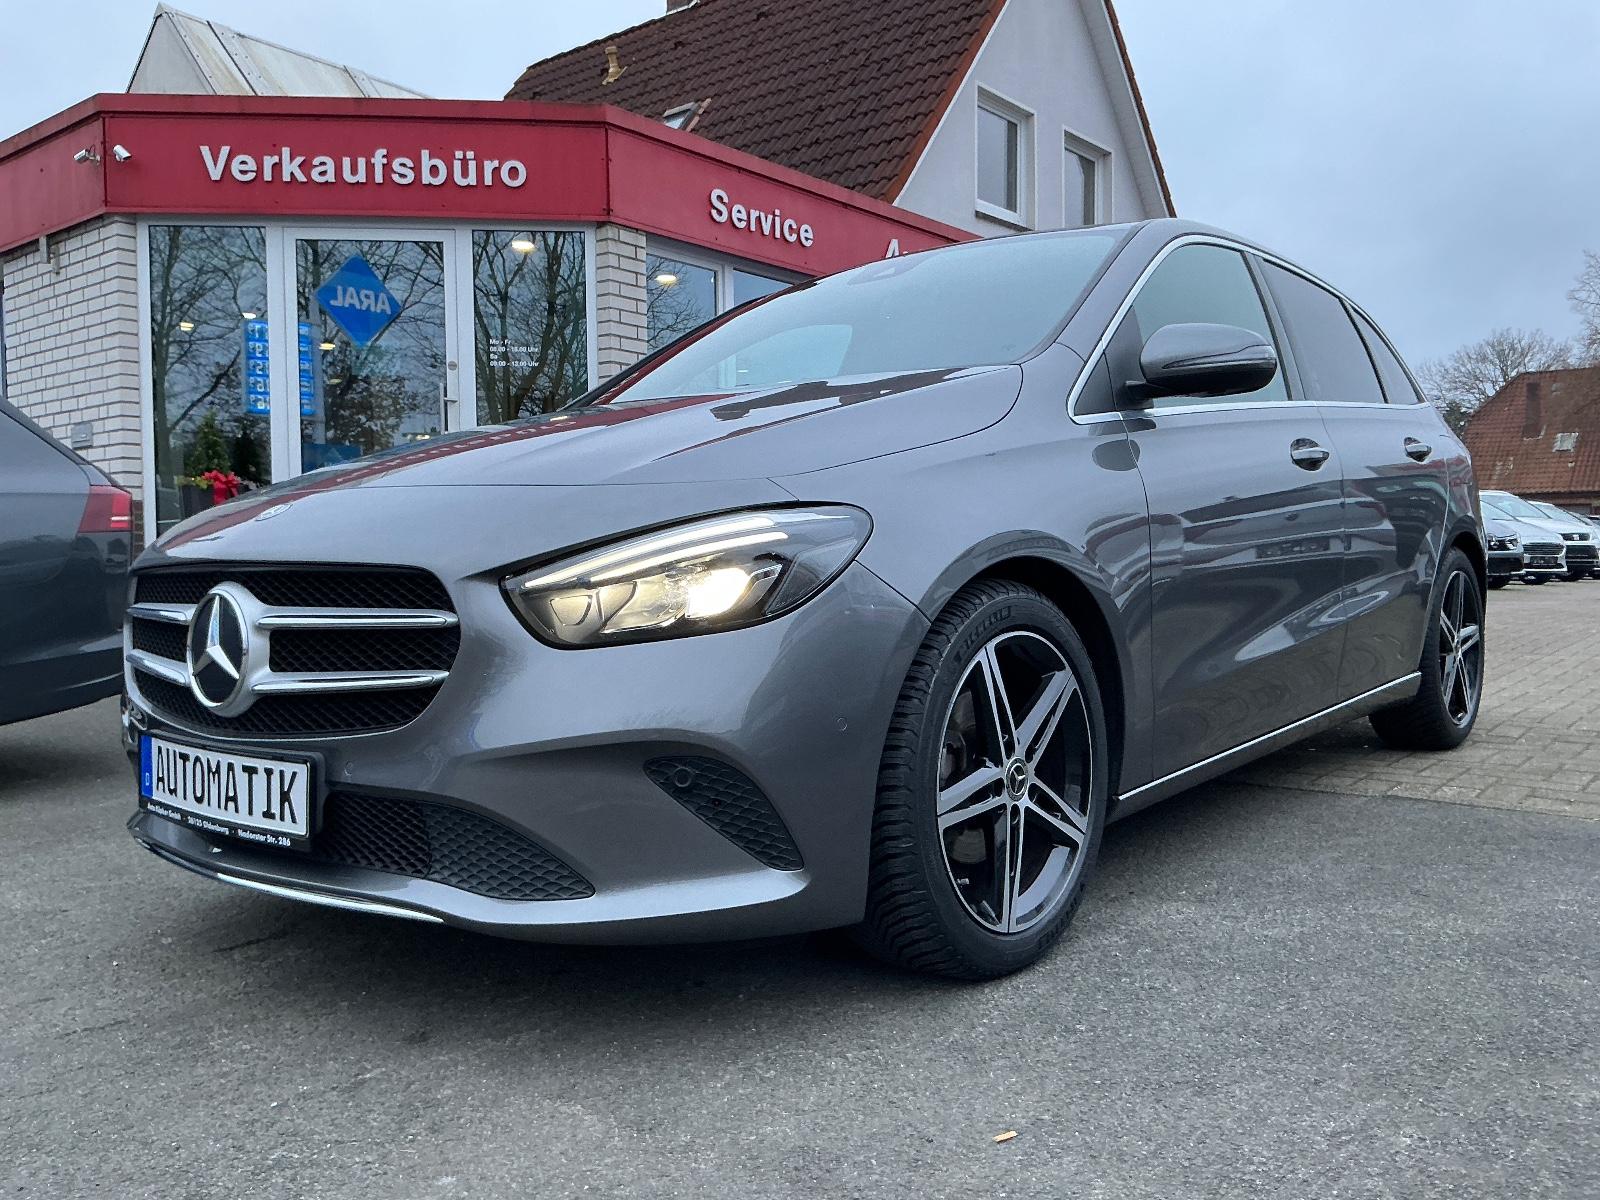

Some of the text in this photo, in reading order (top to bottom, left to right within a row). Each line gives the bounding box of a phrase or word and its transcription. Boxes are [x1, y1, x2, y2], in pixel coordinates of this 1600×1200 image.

[199, 145, 527, 188] Verkaufsbüro
[709, 188, 815, 248] Service
[156, 745, 298, 824] AUTOMATIK
